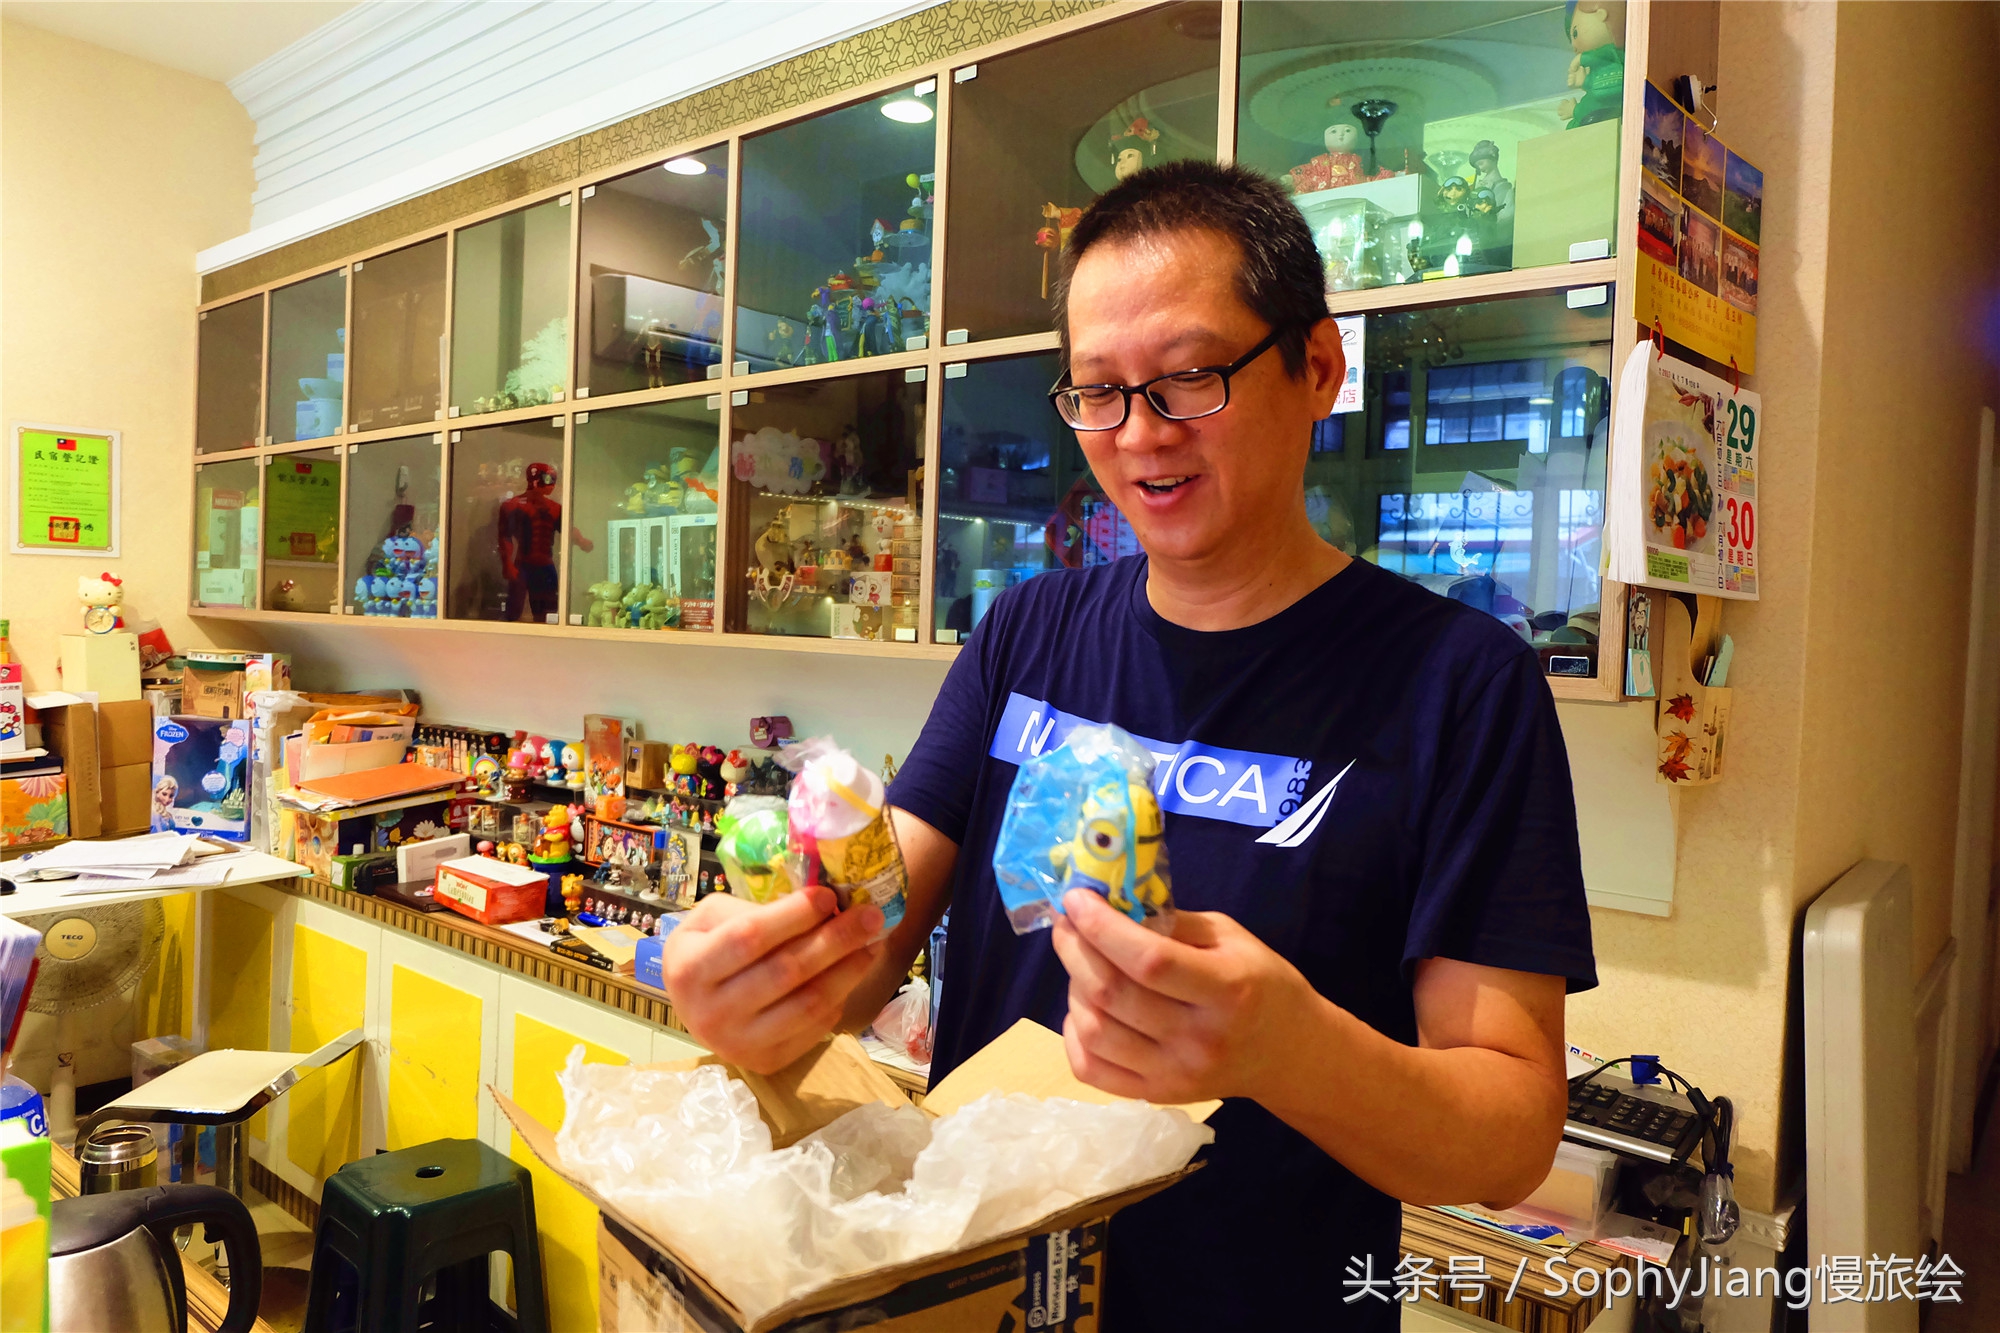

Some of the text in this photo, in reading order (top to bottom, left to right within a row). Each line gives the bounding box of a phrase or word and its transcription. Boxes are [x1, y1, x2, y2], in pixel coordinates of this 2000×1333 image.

[1727, 398, 1756, 453] 29
[1726, 448, 1753, 471] 星期六
[1727, 497, 1755, 550] 30
[1727, 548, 1753, 568] 星期日
[160, 729, 184, 738] FROZEN
[1275, 757, 1313, 825] 983
